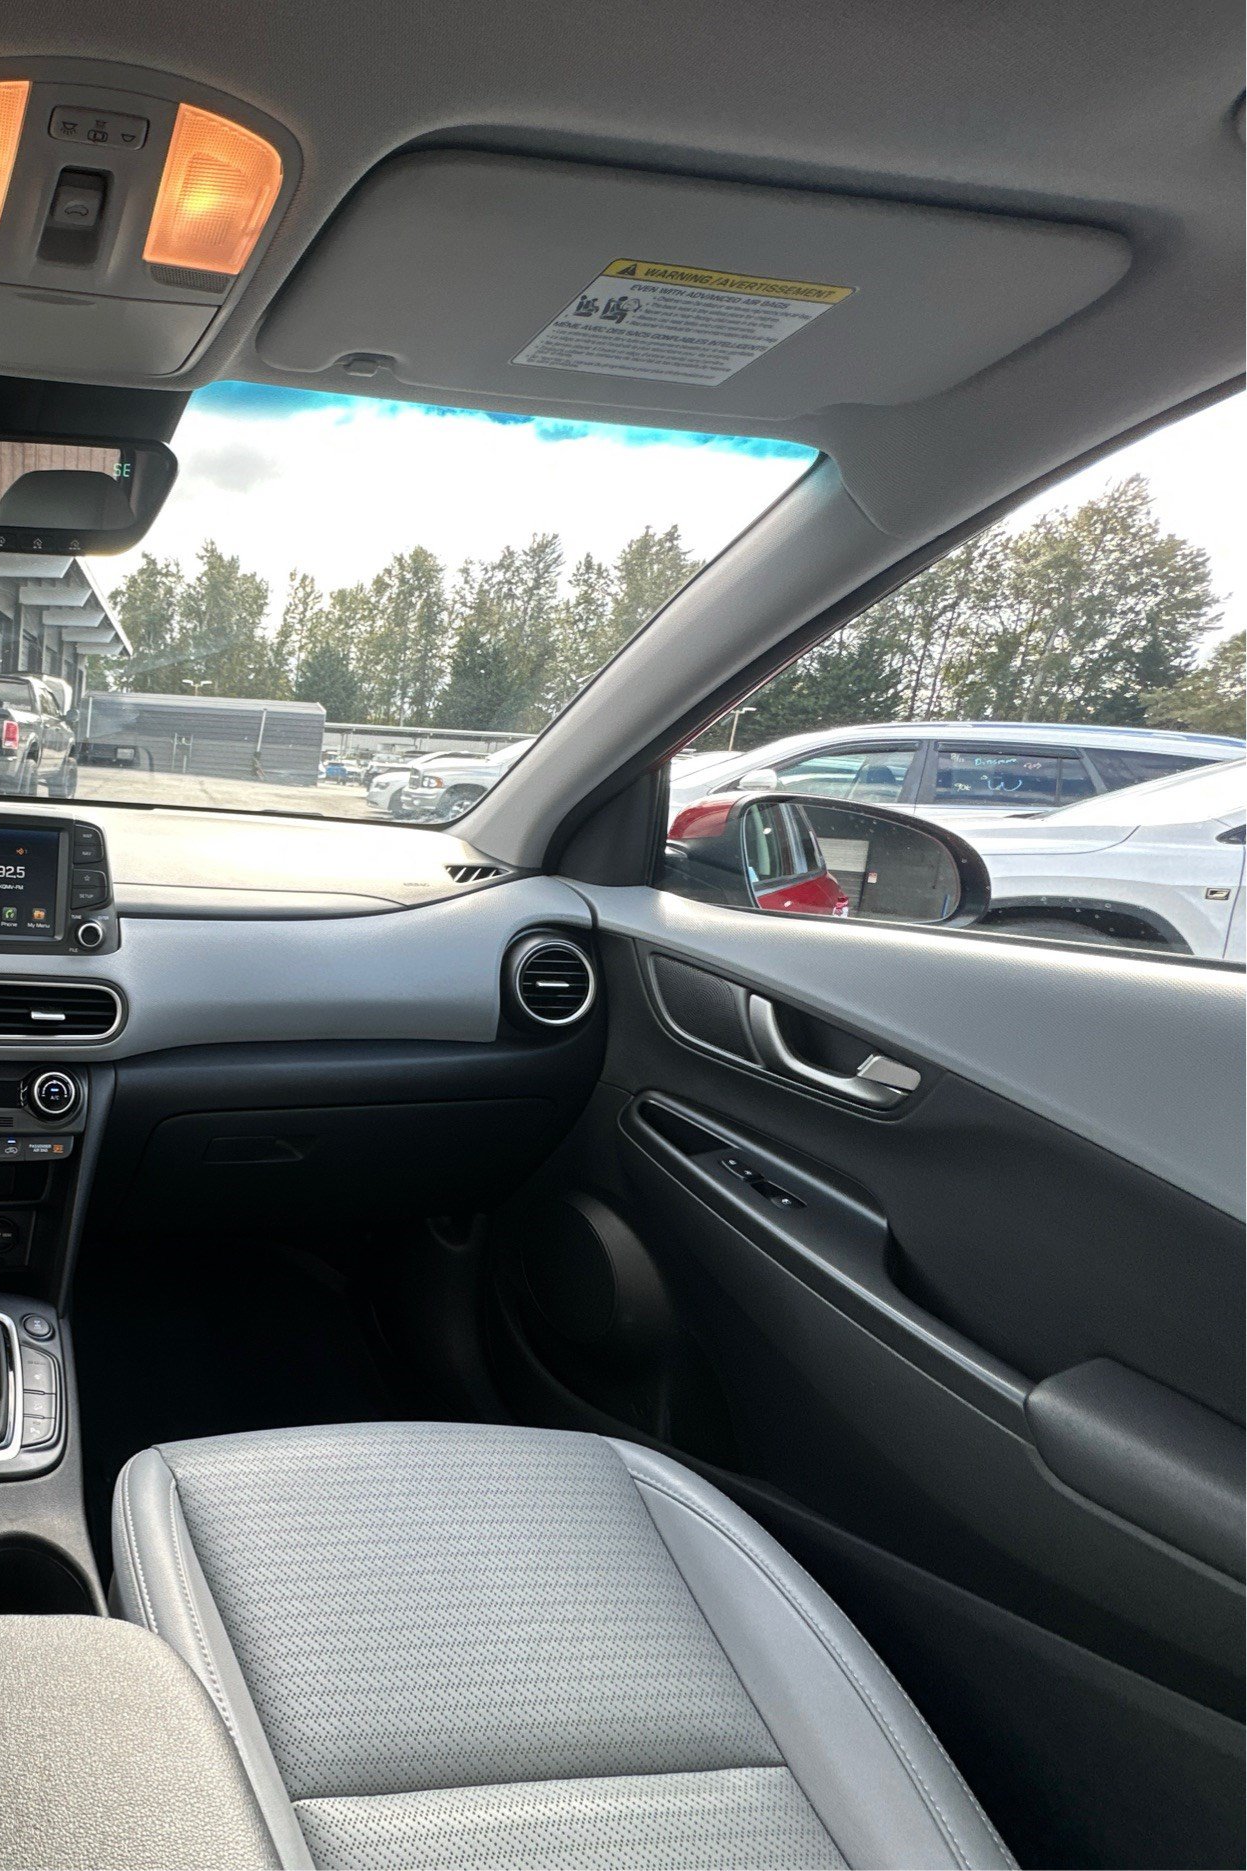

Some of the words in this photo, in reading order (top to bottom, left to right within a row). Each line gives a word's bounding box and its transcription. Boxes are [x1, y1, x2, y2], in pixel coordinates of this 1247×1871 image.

[644, 268, 713, 284] WARNING
[630, 284, 660, 293] EVEN
[660, 288, 686, 297] WITH
[686, 291, 741, 303] ADVANCED
[113, 463, 131, 479] SE
